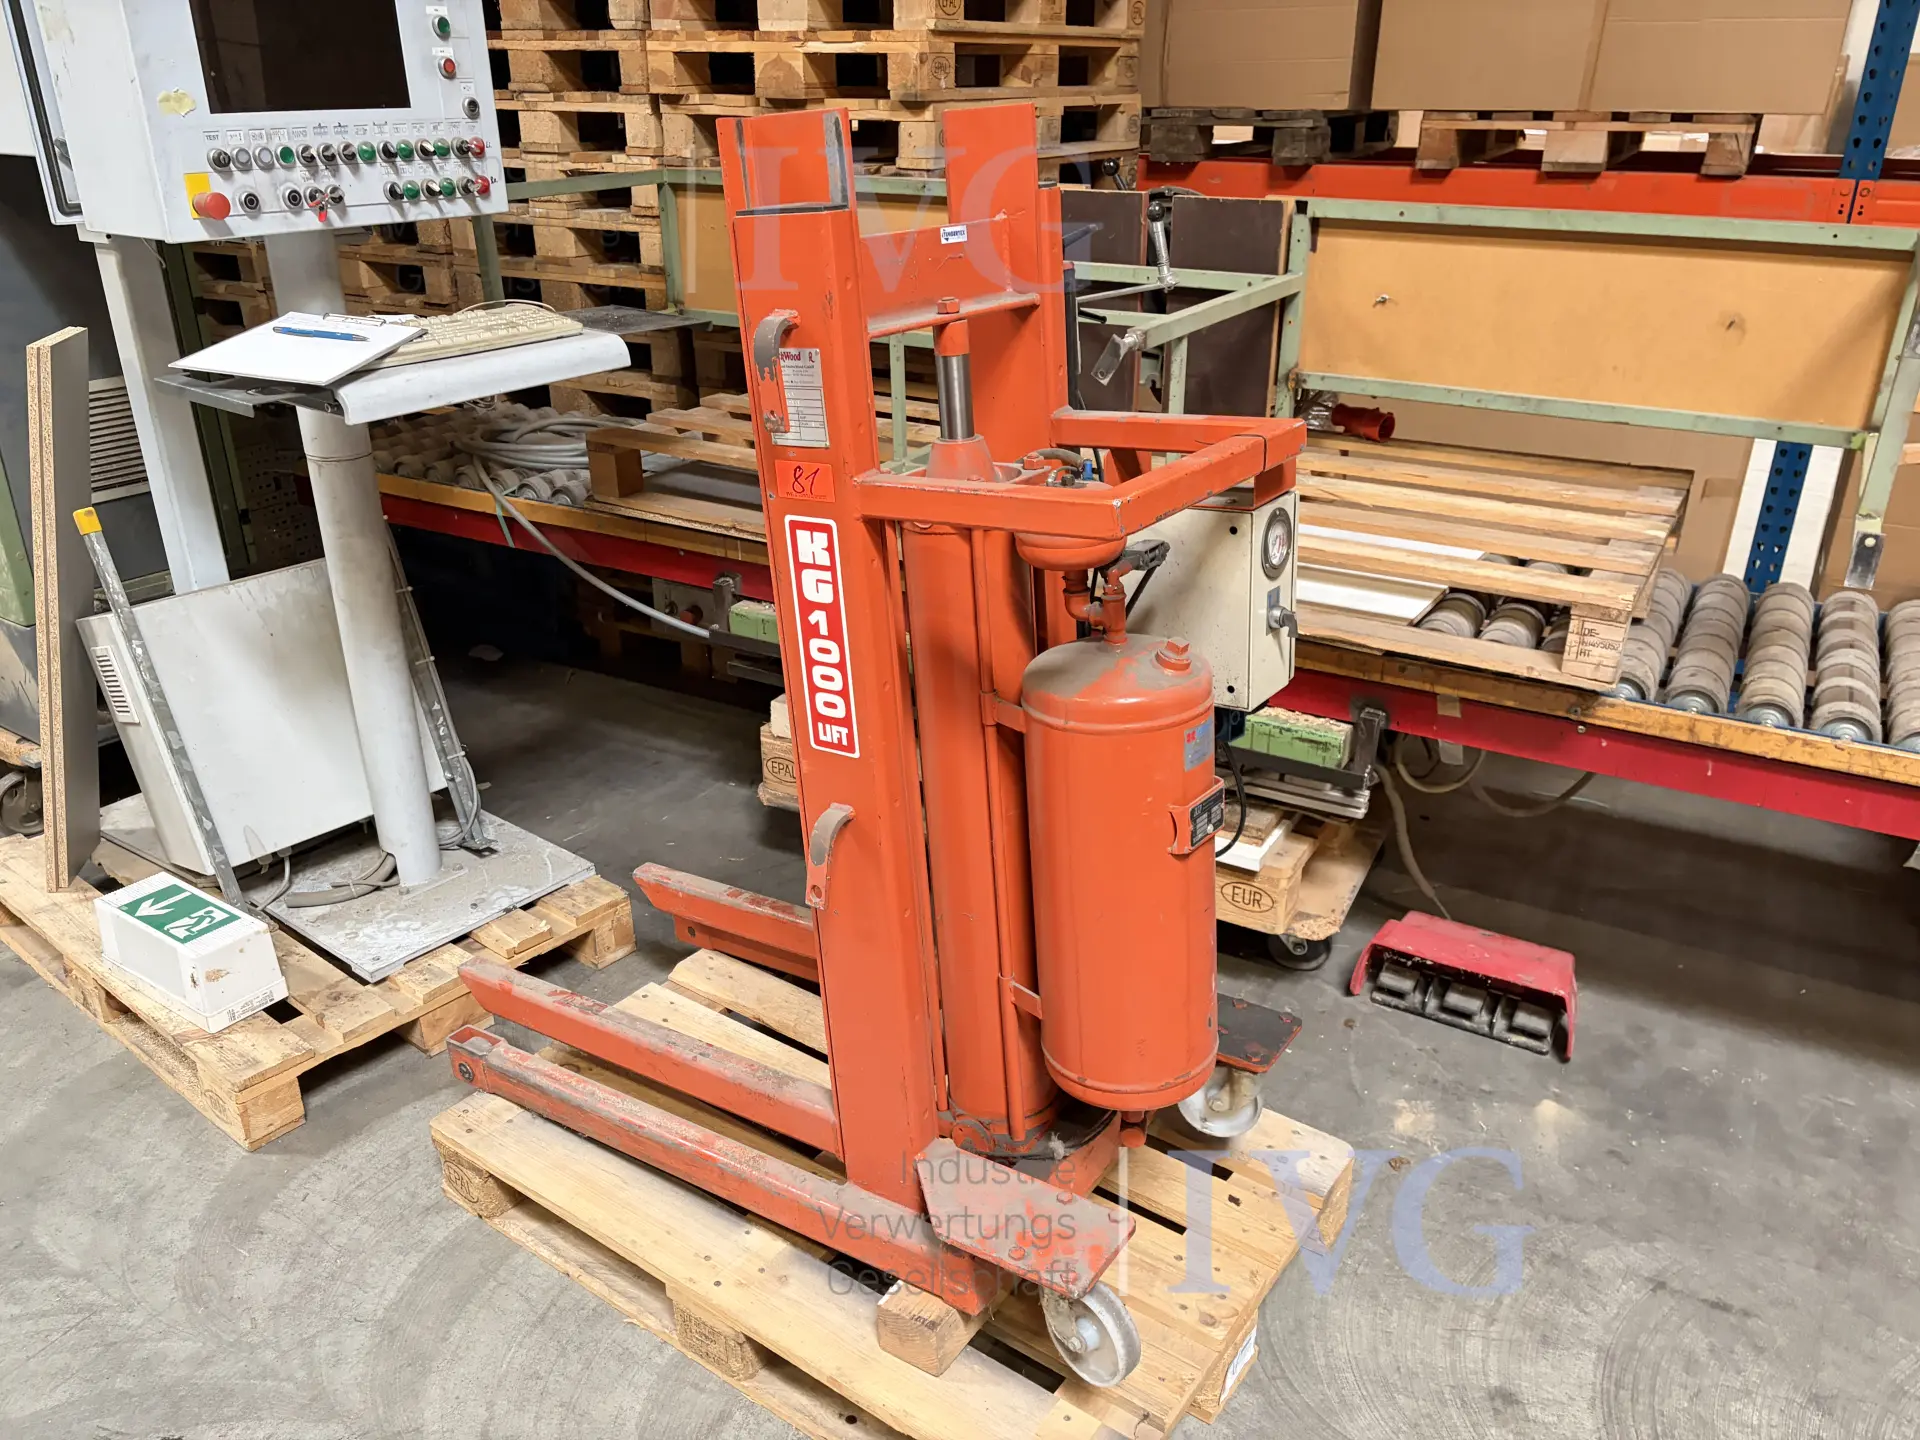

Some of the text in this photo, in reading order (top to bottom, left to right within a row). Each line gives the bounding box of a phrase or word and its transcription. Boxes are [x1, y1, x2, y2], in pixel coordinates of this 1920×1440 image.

[1579, 649, 1592, 657] HT
[817, 722, 848, 747] LIFT
[771, 760, 796, 779] EPAL
[1231, 885, 1263, 909] EUR
